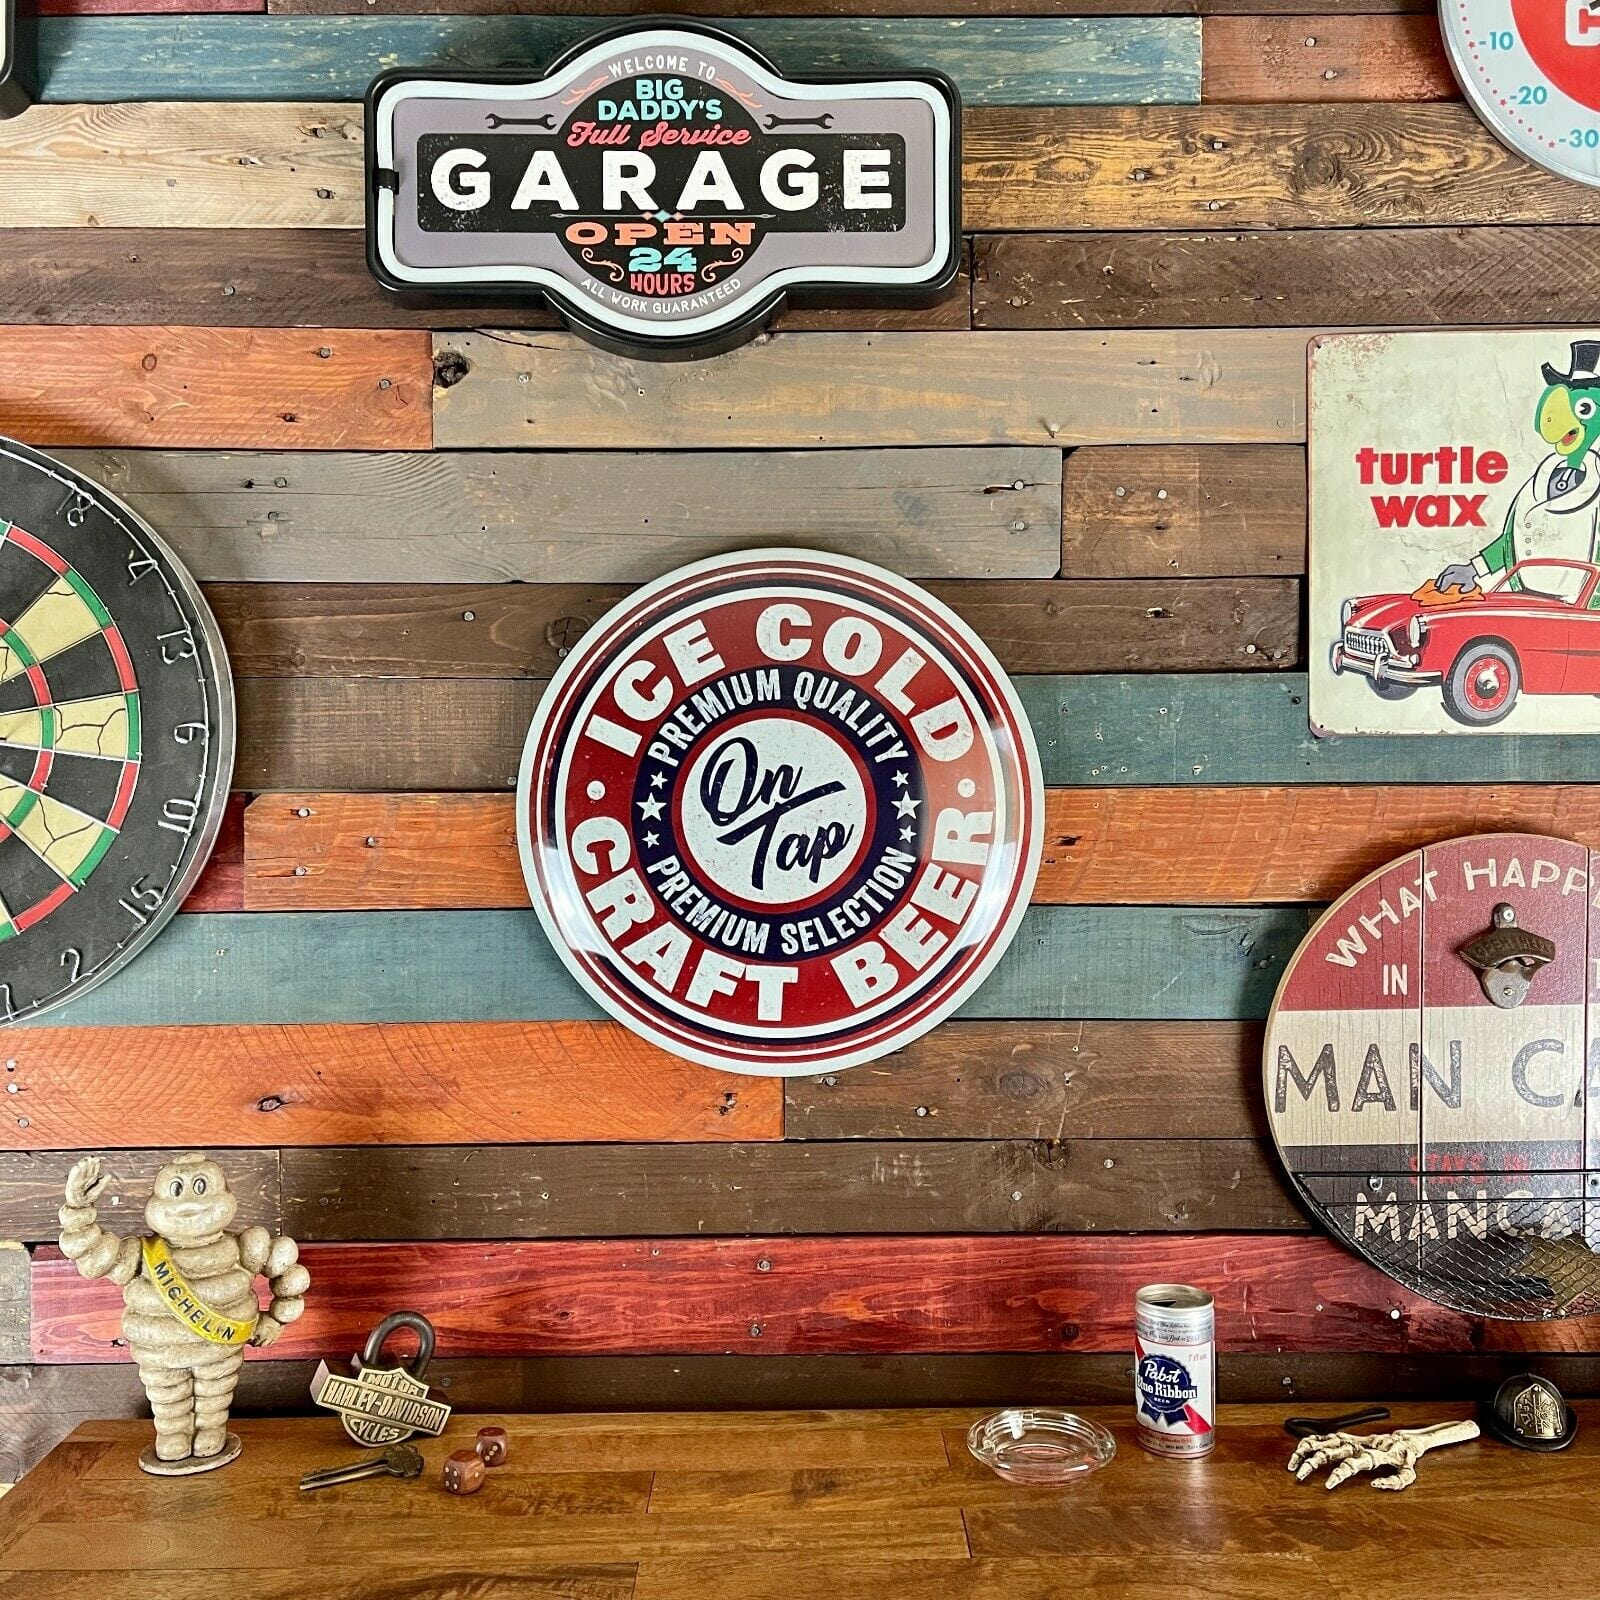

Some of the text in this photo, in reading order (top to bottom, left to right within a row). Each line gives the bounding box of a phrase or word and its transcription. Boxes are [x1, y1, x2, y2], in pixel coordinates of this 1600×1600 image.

[1479, 31, 1514, 51] -10
[608, 54, 716, 81] WELCOME TO
[636, 78, 684, 100] BIG
[1509, 85, 1548, 105] -20
[598, 99, 723, 121] DADDY'S
[567, 121, 752, 150] Full Service
[1558, 129, 1600, 149] -30
[430, 147, 893, 212] GARAGE
[565, 221, 756, 246] OPEN
[628, 247, 697, 273] 24
[580, 278, 742, 315] ALL WORK GUARANTEED
[630, 273, 695, 296] HOURS
[1355, 446, 1509, 485] turtle
[1370, 494, 1488, 529] wax
[584, 603, 975, 762] ICE COLD
[647, 668, 909, 767] PREMIUM QUALITY
[699, 736, 803, 826] On
[716, 779, 854, 891] Tap
[571, 807, 994, 1022] CRAFT BEER
[646, 846, 917, 955] PREMIUM SELECTION
[1325, 857, 1600, 968] WHAT HAPP
[1382, 963, 1409, 996] IN
[1274, 1039, 1462, 1114] MAN
[154, 1261, 235, 1341] MICHELIN
[366, 1373, 420, 1396] MOTOR
[1143, 1360, 1182, 1383] Pabst
[323, 1381, 445, 1430] HARLEY-DAVIDSON
[1154, 1381, 1197, 1399] Ribbon
[350, 1418, 400, 1442] CYCLES
